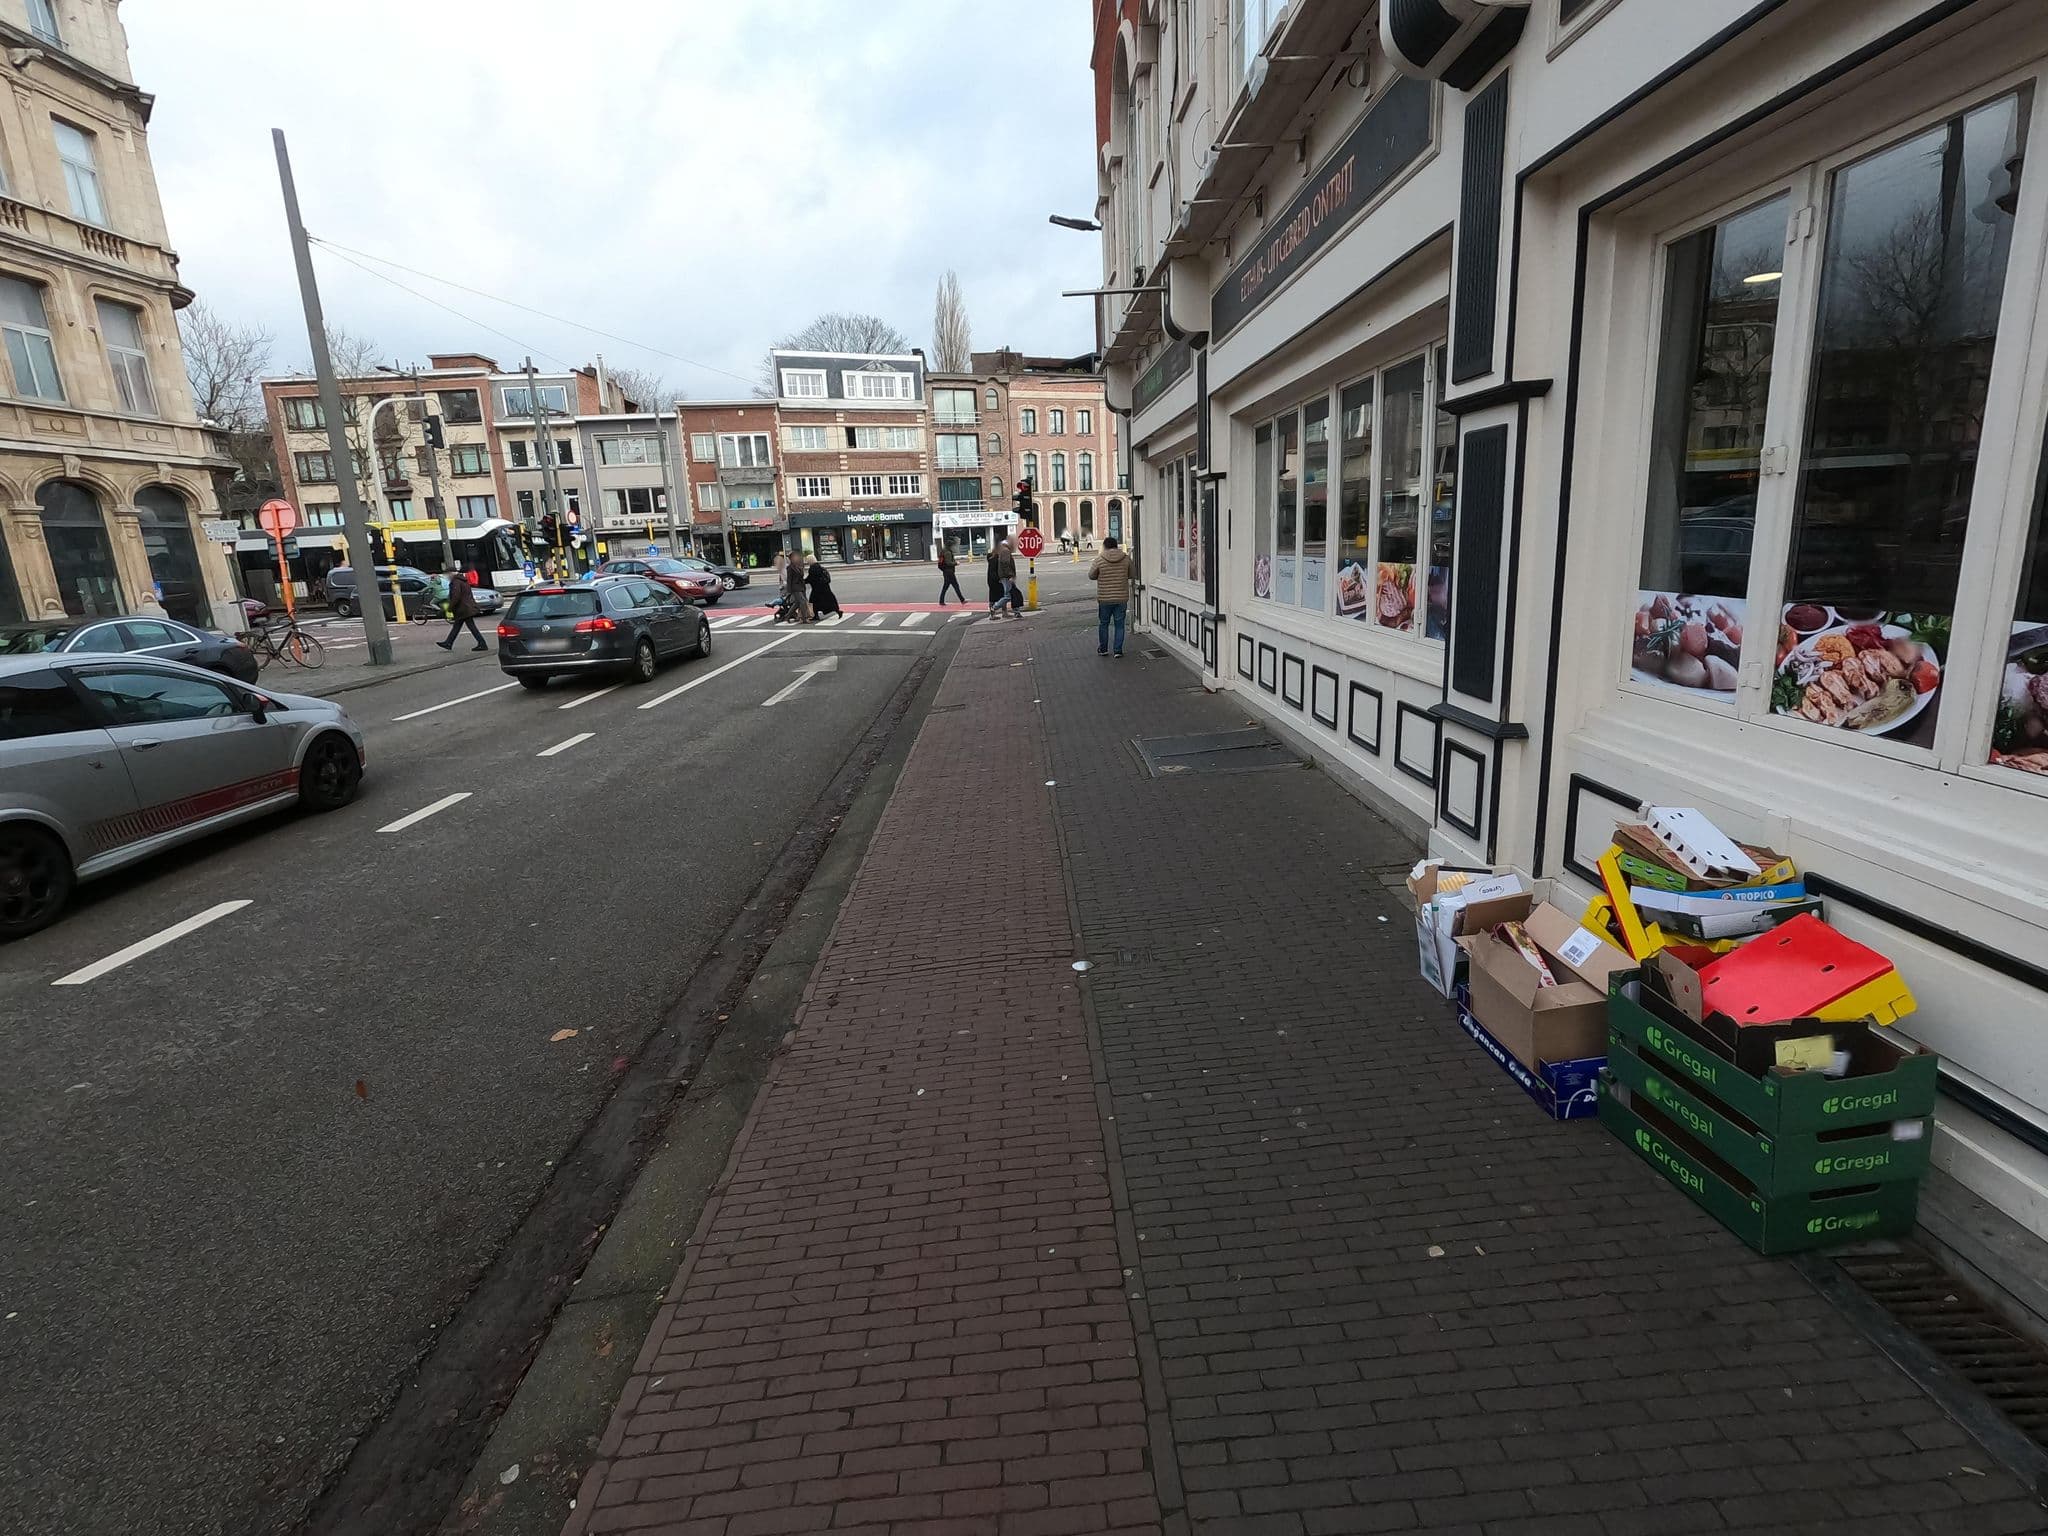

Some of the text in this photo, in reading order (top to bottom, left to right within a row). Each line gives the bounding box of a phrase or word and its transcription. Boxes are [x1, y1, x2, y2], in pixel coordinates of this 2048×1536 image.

[1267, 206, 1311, 274] UITGEBREID
[1312, 154, 1355, 227] ONTBIJT
[1018, 535, 1043, 550] STOP
[1735, 890, 1775, 901] TROPICO
[1663, 1037, 1718, 1085] Gregal
[1840, 1089, 1898, 1111] Gregal
[1652, 1141, 1705, 1194] Gregal
[1833, 1151, 1890, 1174] Gregal
